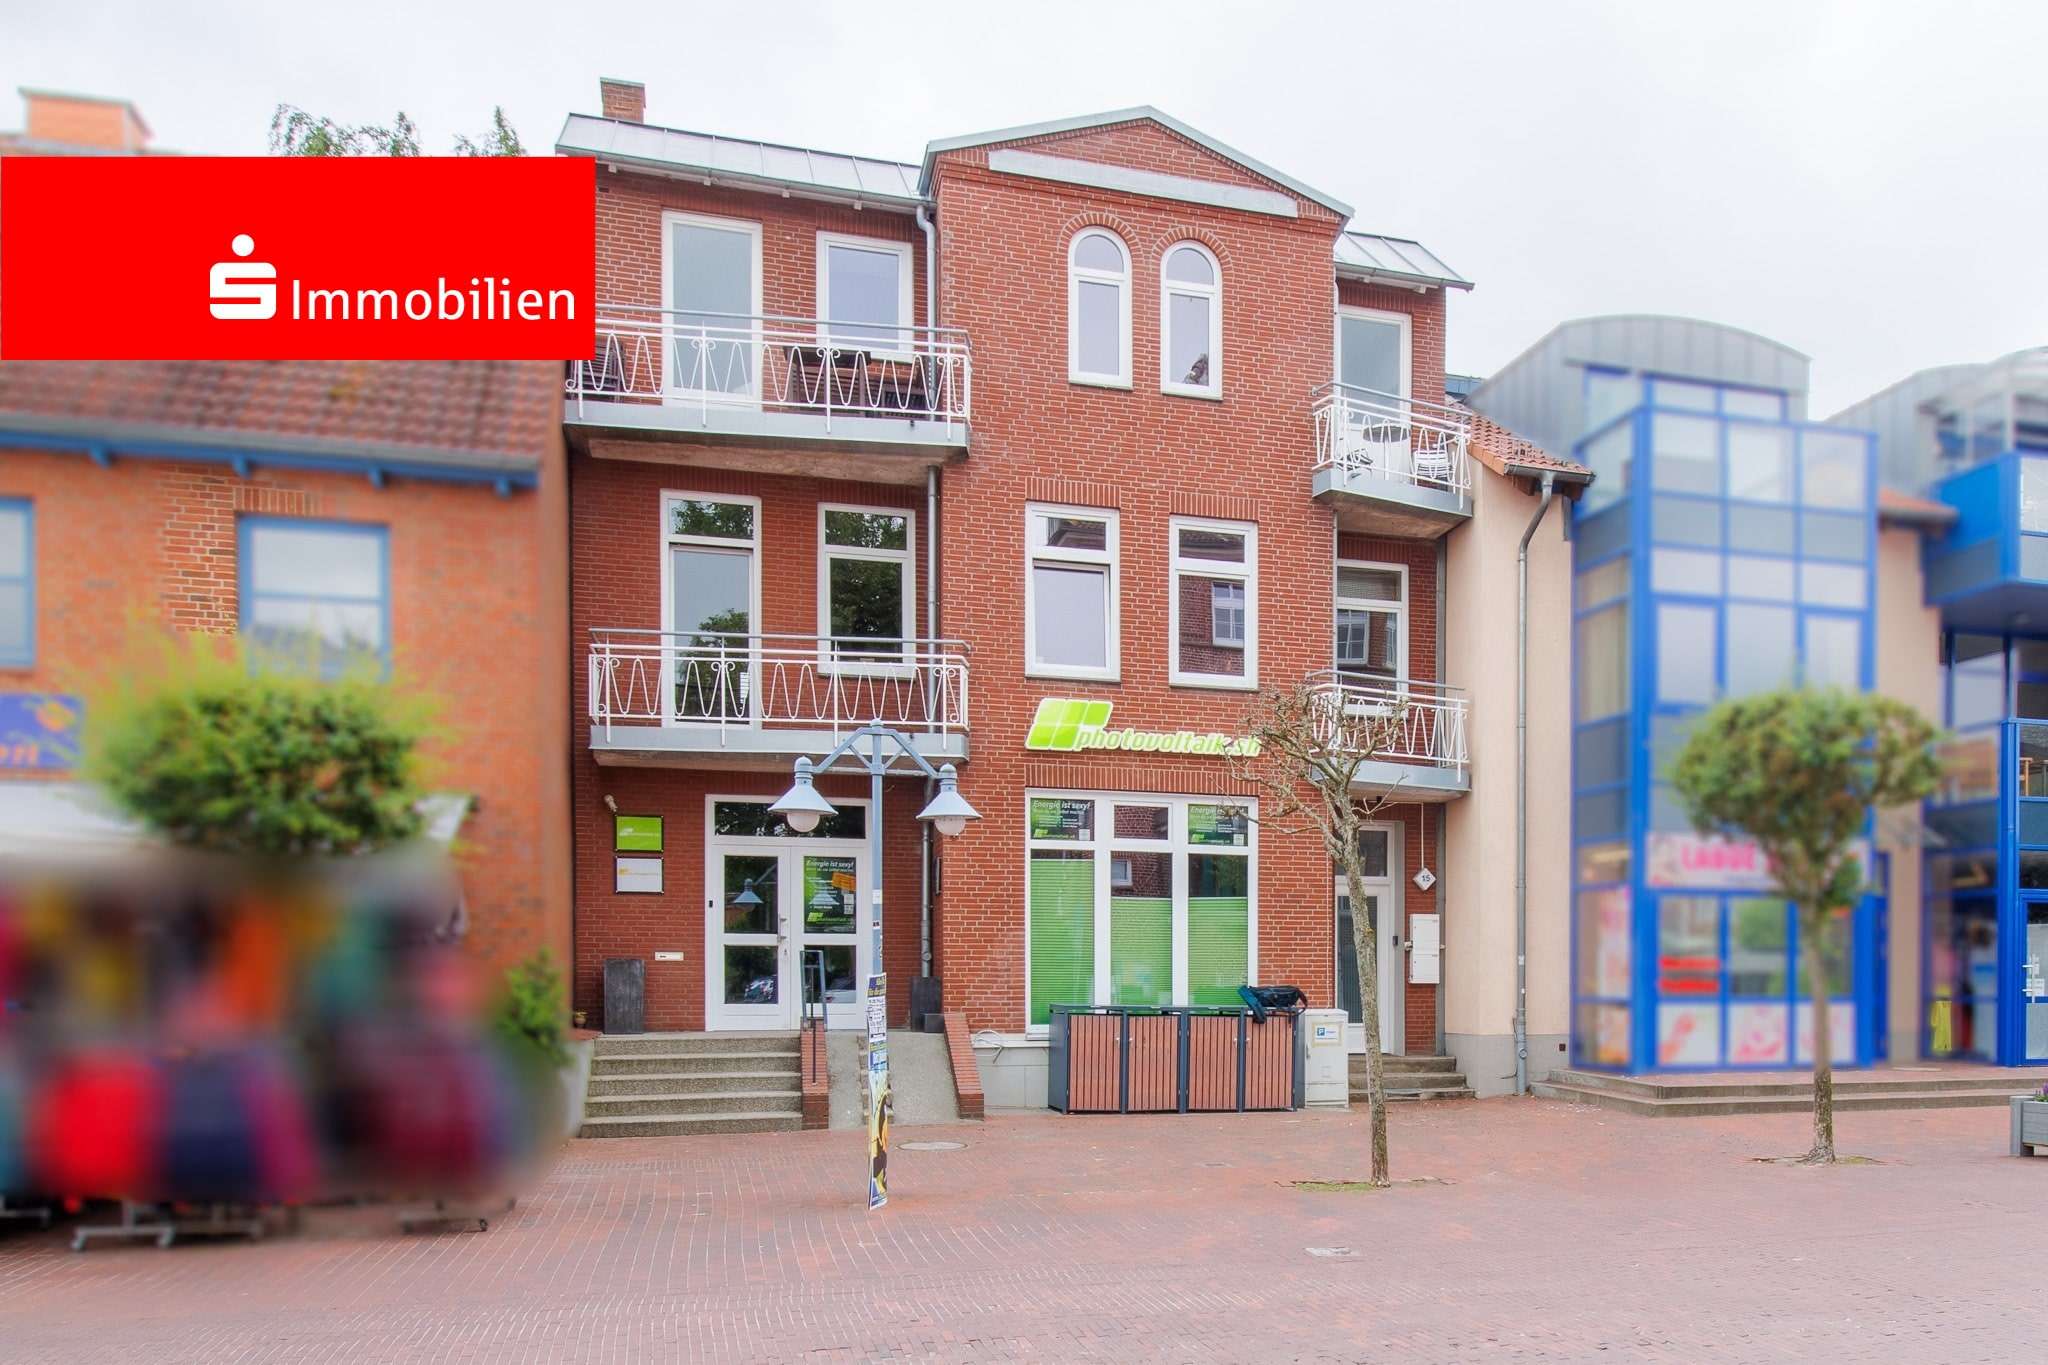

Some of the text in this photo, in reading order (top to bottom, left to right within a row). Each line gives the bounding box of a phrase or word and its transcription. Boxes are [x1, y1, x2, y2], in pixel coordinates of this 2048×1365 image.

[1076, 729, 1260, 755] photovoltaik.sh
[1033, 800, 1060, 809] Energie
[1062, 801, 1071, 809] ist
[805, 859, 829, 868] Energie
[830, 860, 839, 868] ist
[1422, 874, 1431, 882] 15
